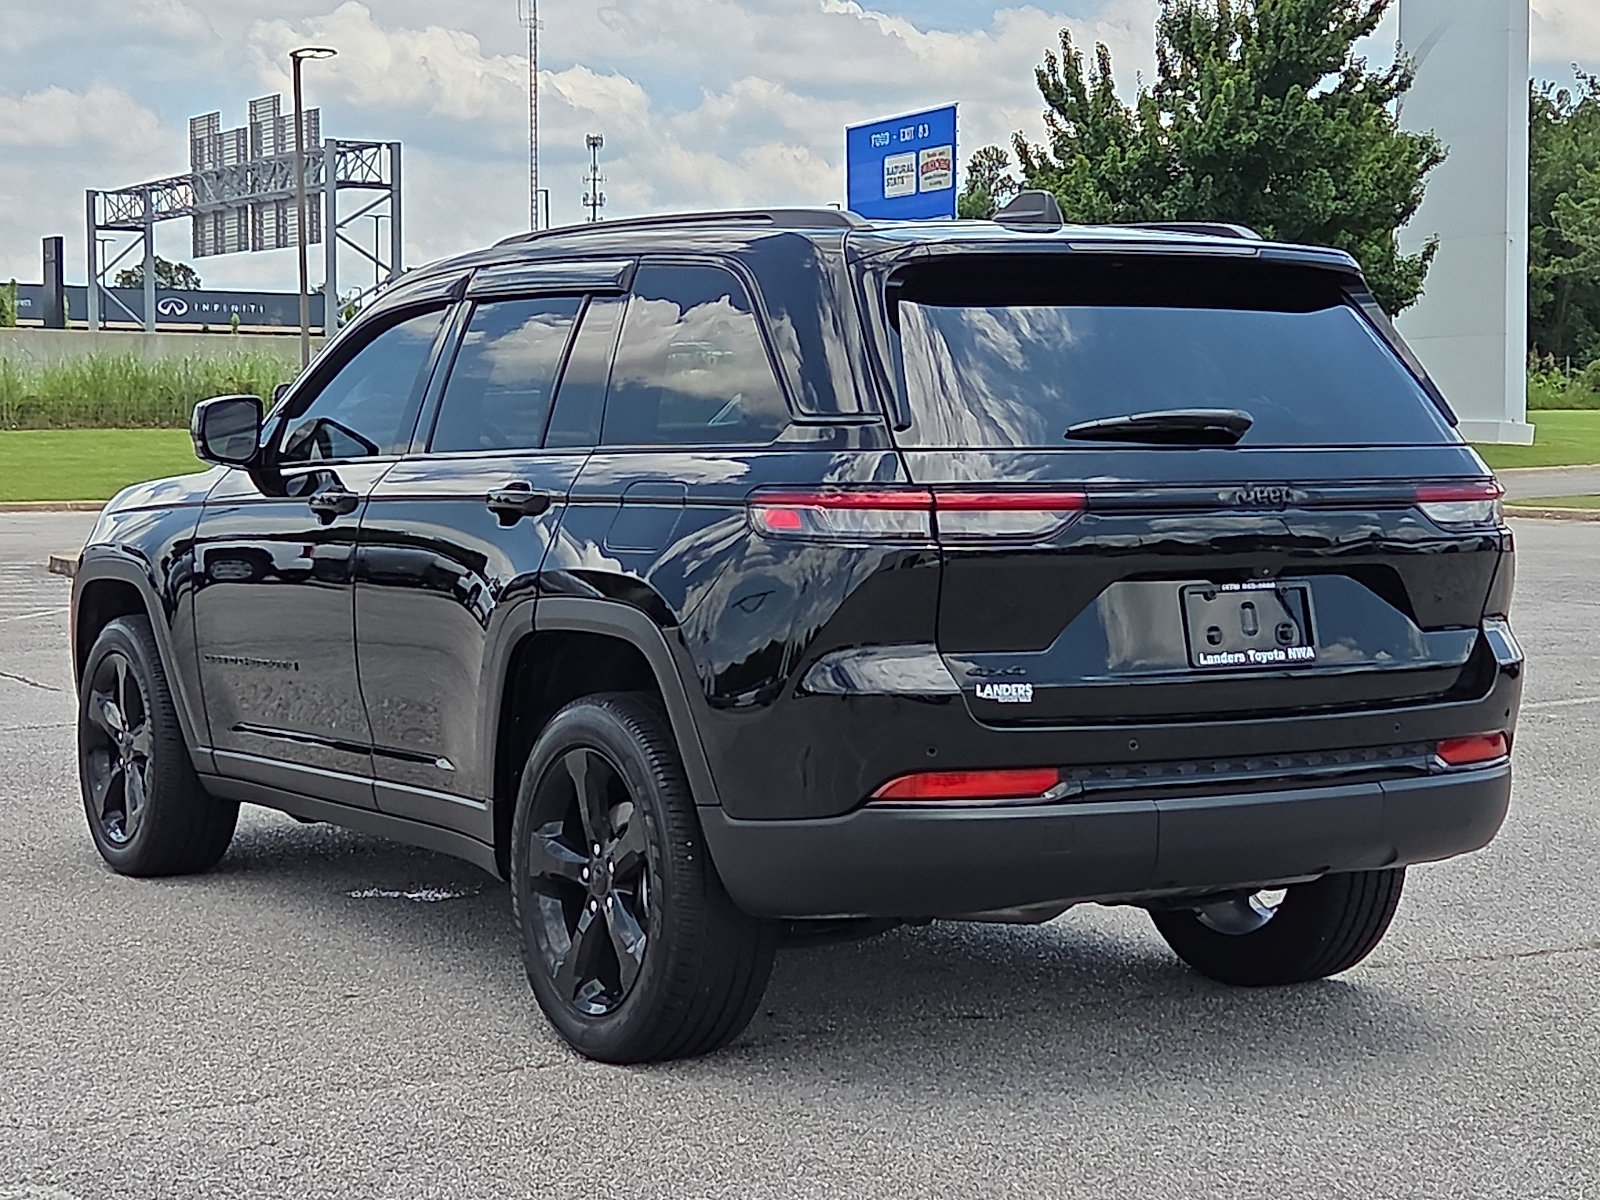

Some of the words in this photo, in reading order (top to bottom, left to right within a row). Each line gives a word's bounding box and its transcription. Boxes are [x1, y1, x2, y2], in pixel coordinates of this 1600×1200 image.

[900, 126, 914, 142] EXIT
[194, 303, 264, 314] INFINITI
[1200, 652, 1246, 665] Landers
[1248, 648, 1286, 664] Toyota
[1288, 646, 1316, 659] NWA
[975, 683, 1033, 697] LANDERS
